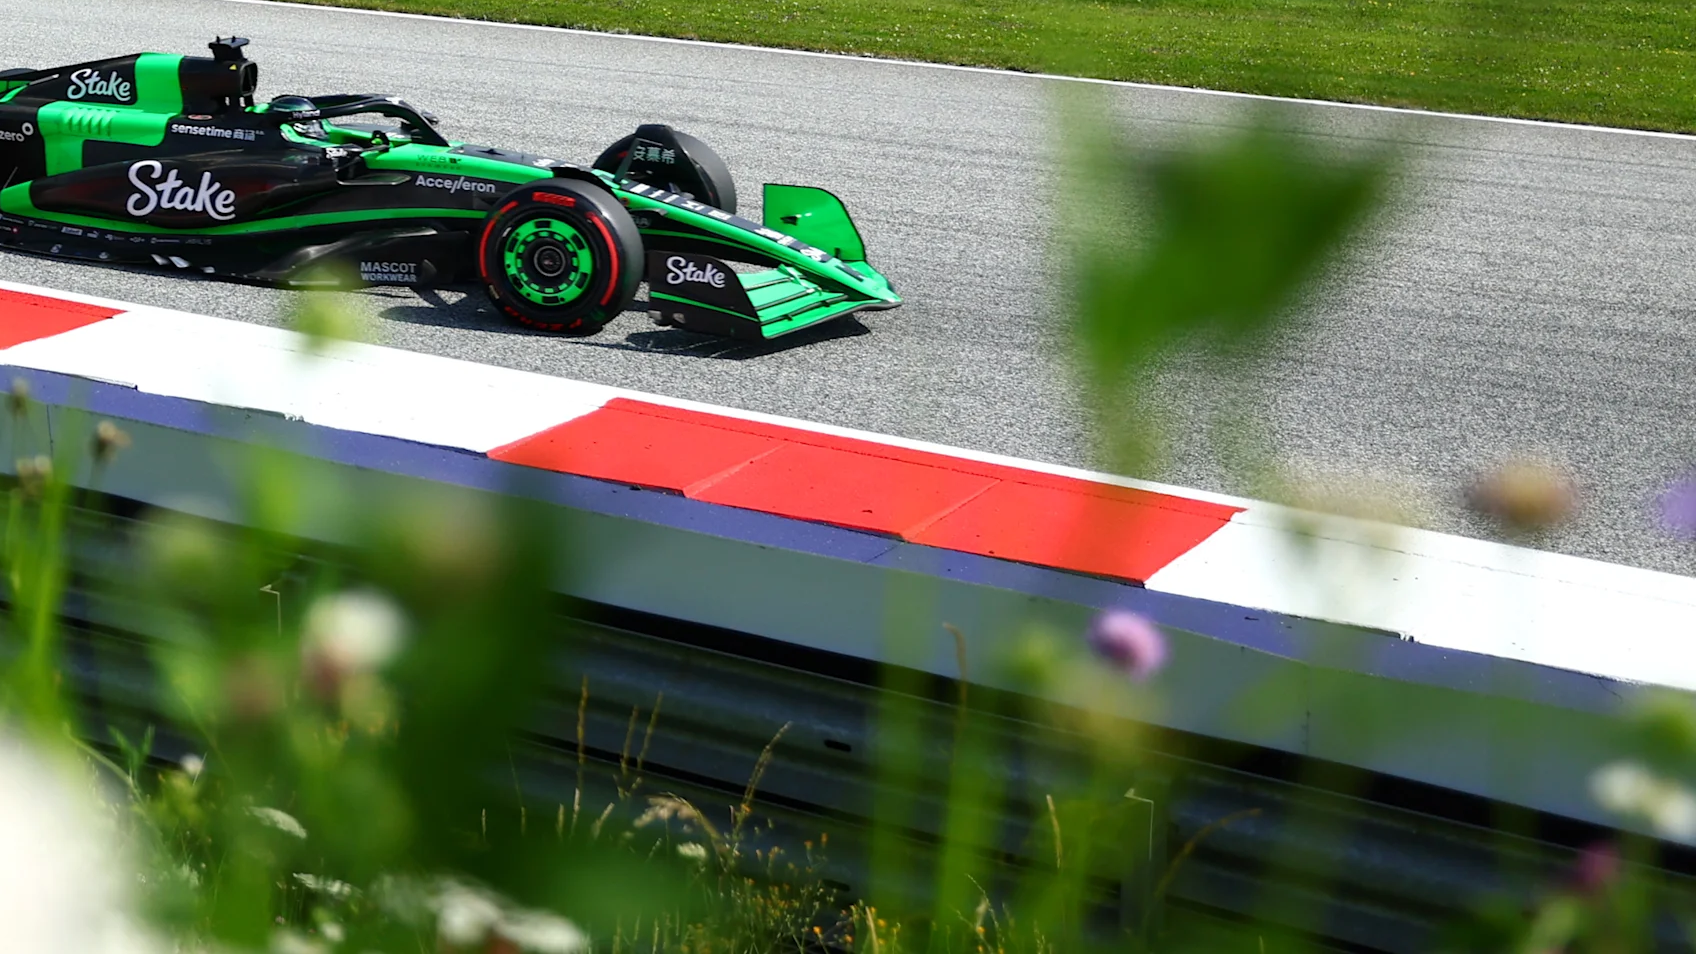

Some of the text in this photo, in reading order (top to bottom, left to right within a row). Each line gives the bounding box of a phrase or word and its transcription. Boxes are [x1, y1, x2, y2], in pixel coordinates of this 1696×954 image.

[67, 68, 131, 101] Stake
[171, 123, 232, 139] sensetime
[126, 159, 236, 221] Stake
[415, 173, 496, 194] Accelleron
[360, 261, 417, 273] MASCOT
[360, 272, 418, 283] WORKWEAR
[667, 256, 726, 288] Stake
